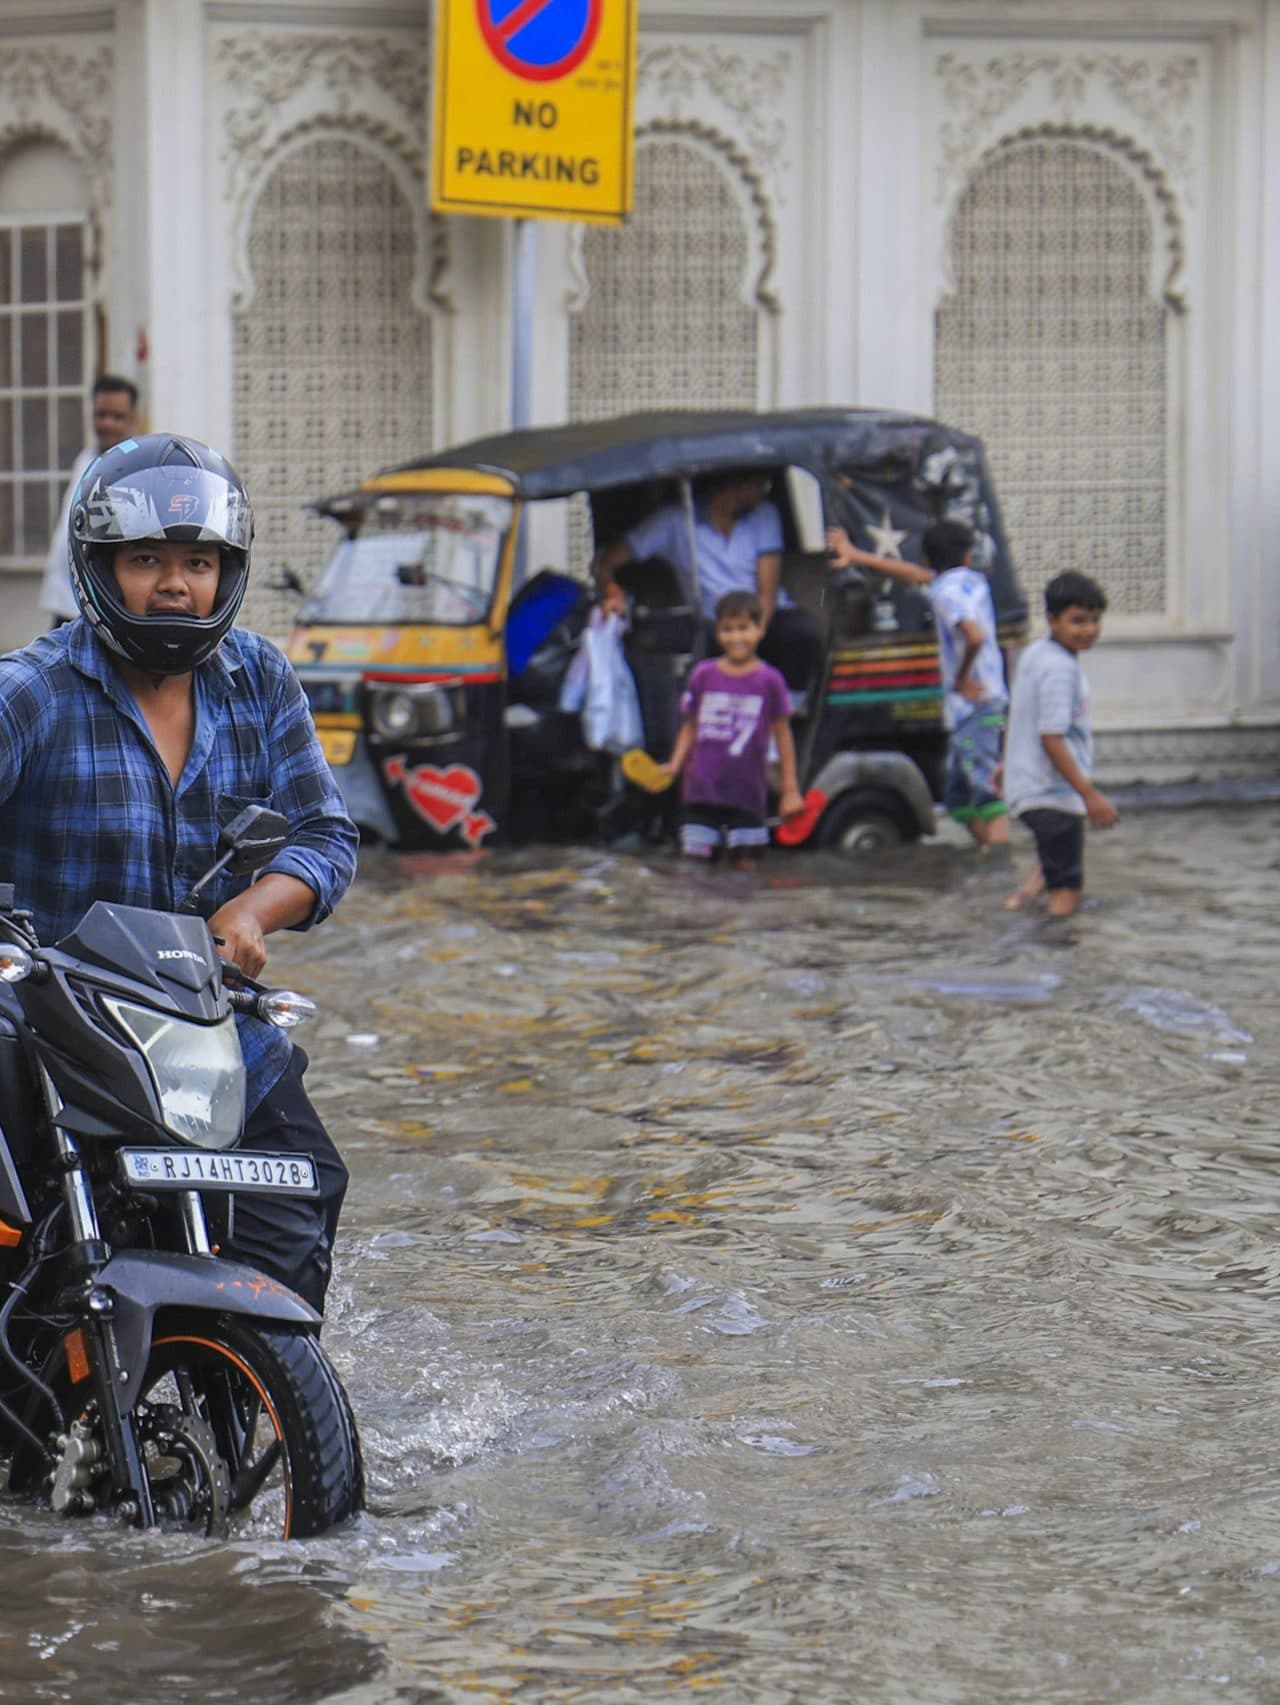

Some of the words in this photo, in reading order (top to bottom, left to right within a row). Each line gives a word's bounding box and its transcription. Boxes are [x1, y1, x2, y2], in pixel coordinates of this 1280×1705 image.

[513, 100, 558, 129] NO
[456, 147, 600, 186] PARKING
[157, 950, 207, 966] HONDA
[164, 1156, 302, 1185] RJ14HT3028
